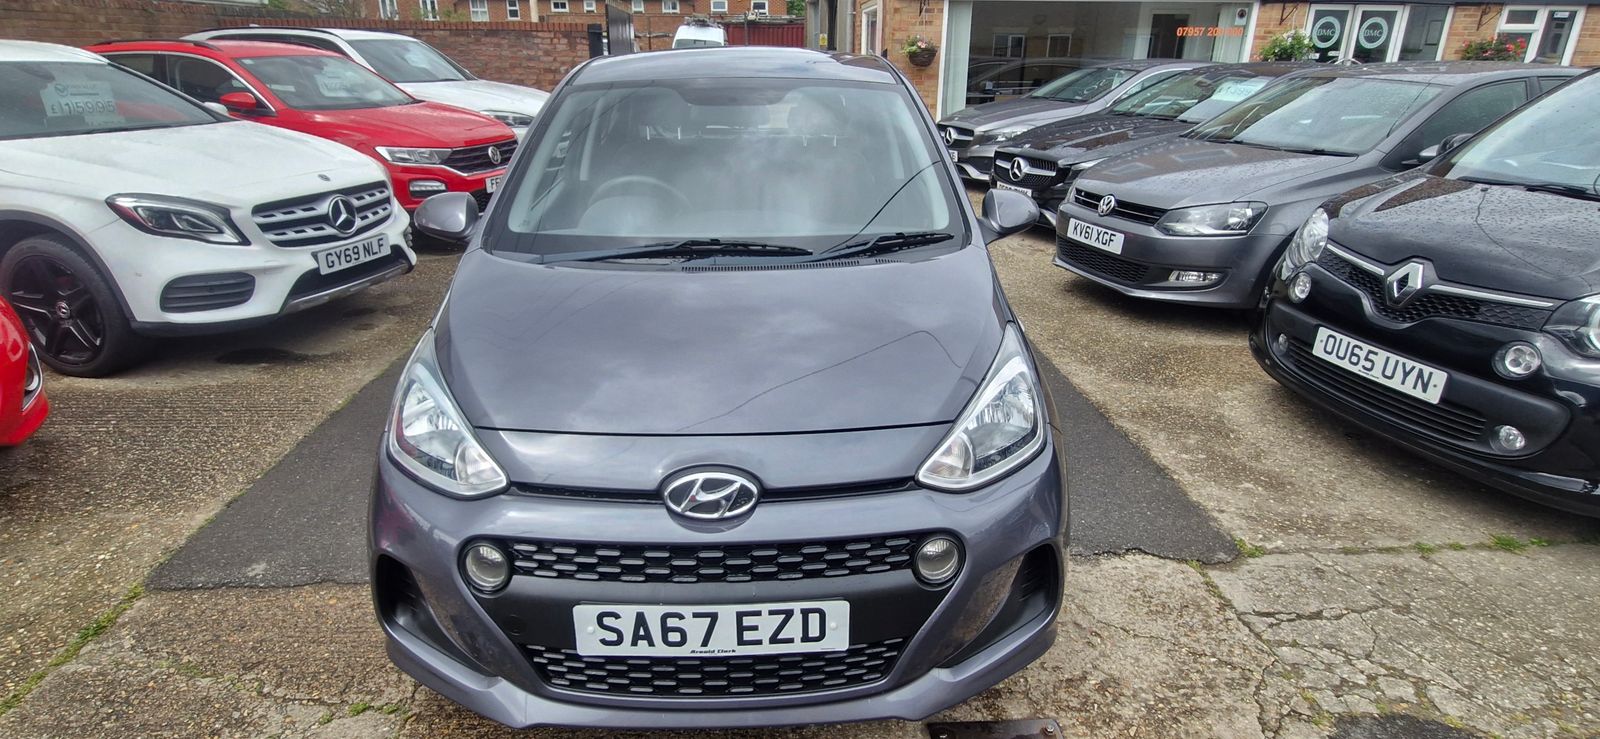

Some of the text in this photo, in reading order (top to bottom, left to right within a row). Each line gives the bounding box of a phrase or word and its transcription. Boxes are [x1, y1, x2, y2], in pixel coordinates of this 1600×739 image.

[1176, 26, 1205, 37] 07957
[1073, 221, 1117, 247] KV61 XGF
[325, 238, 384, 269] GY69 NLF
[1323, 334, 1434, 394] OU65 UYN
[596, 607, 827, 648] SA67 EZD
